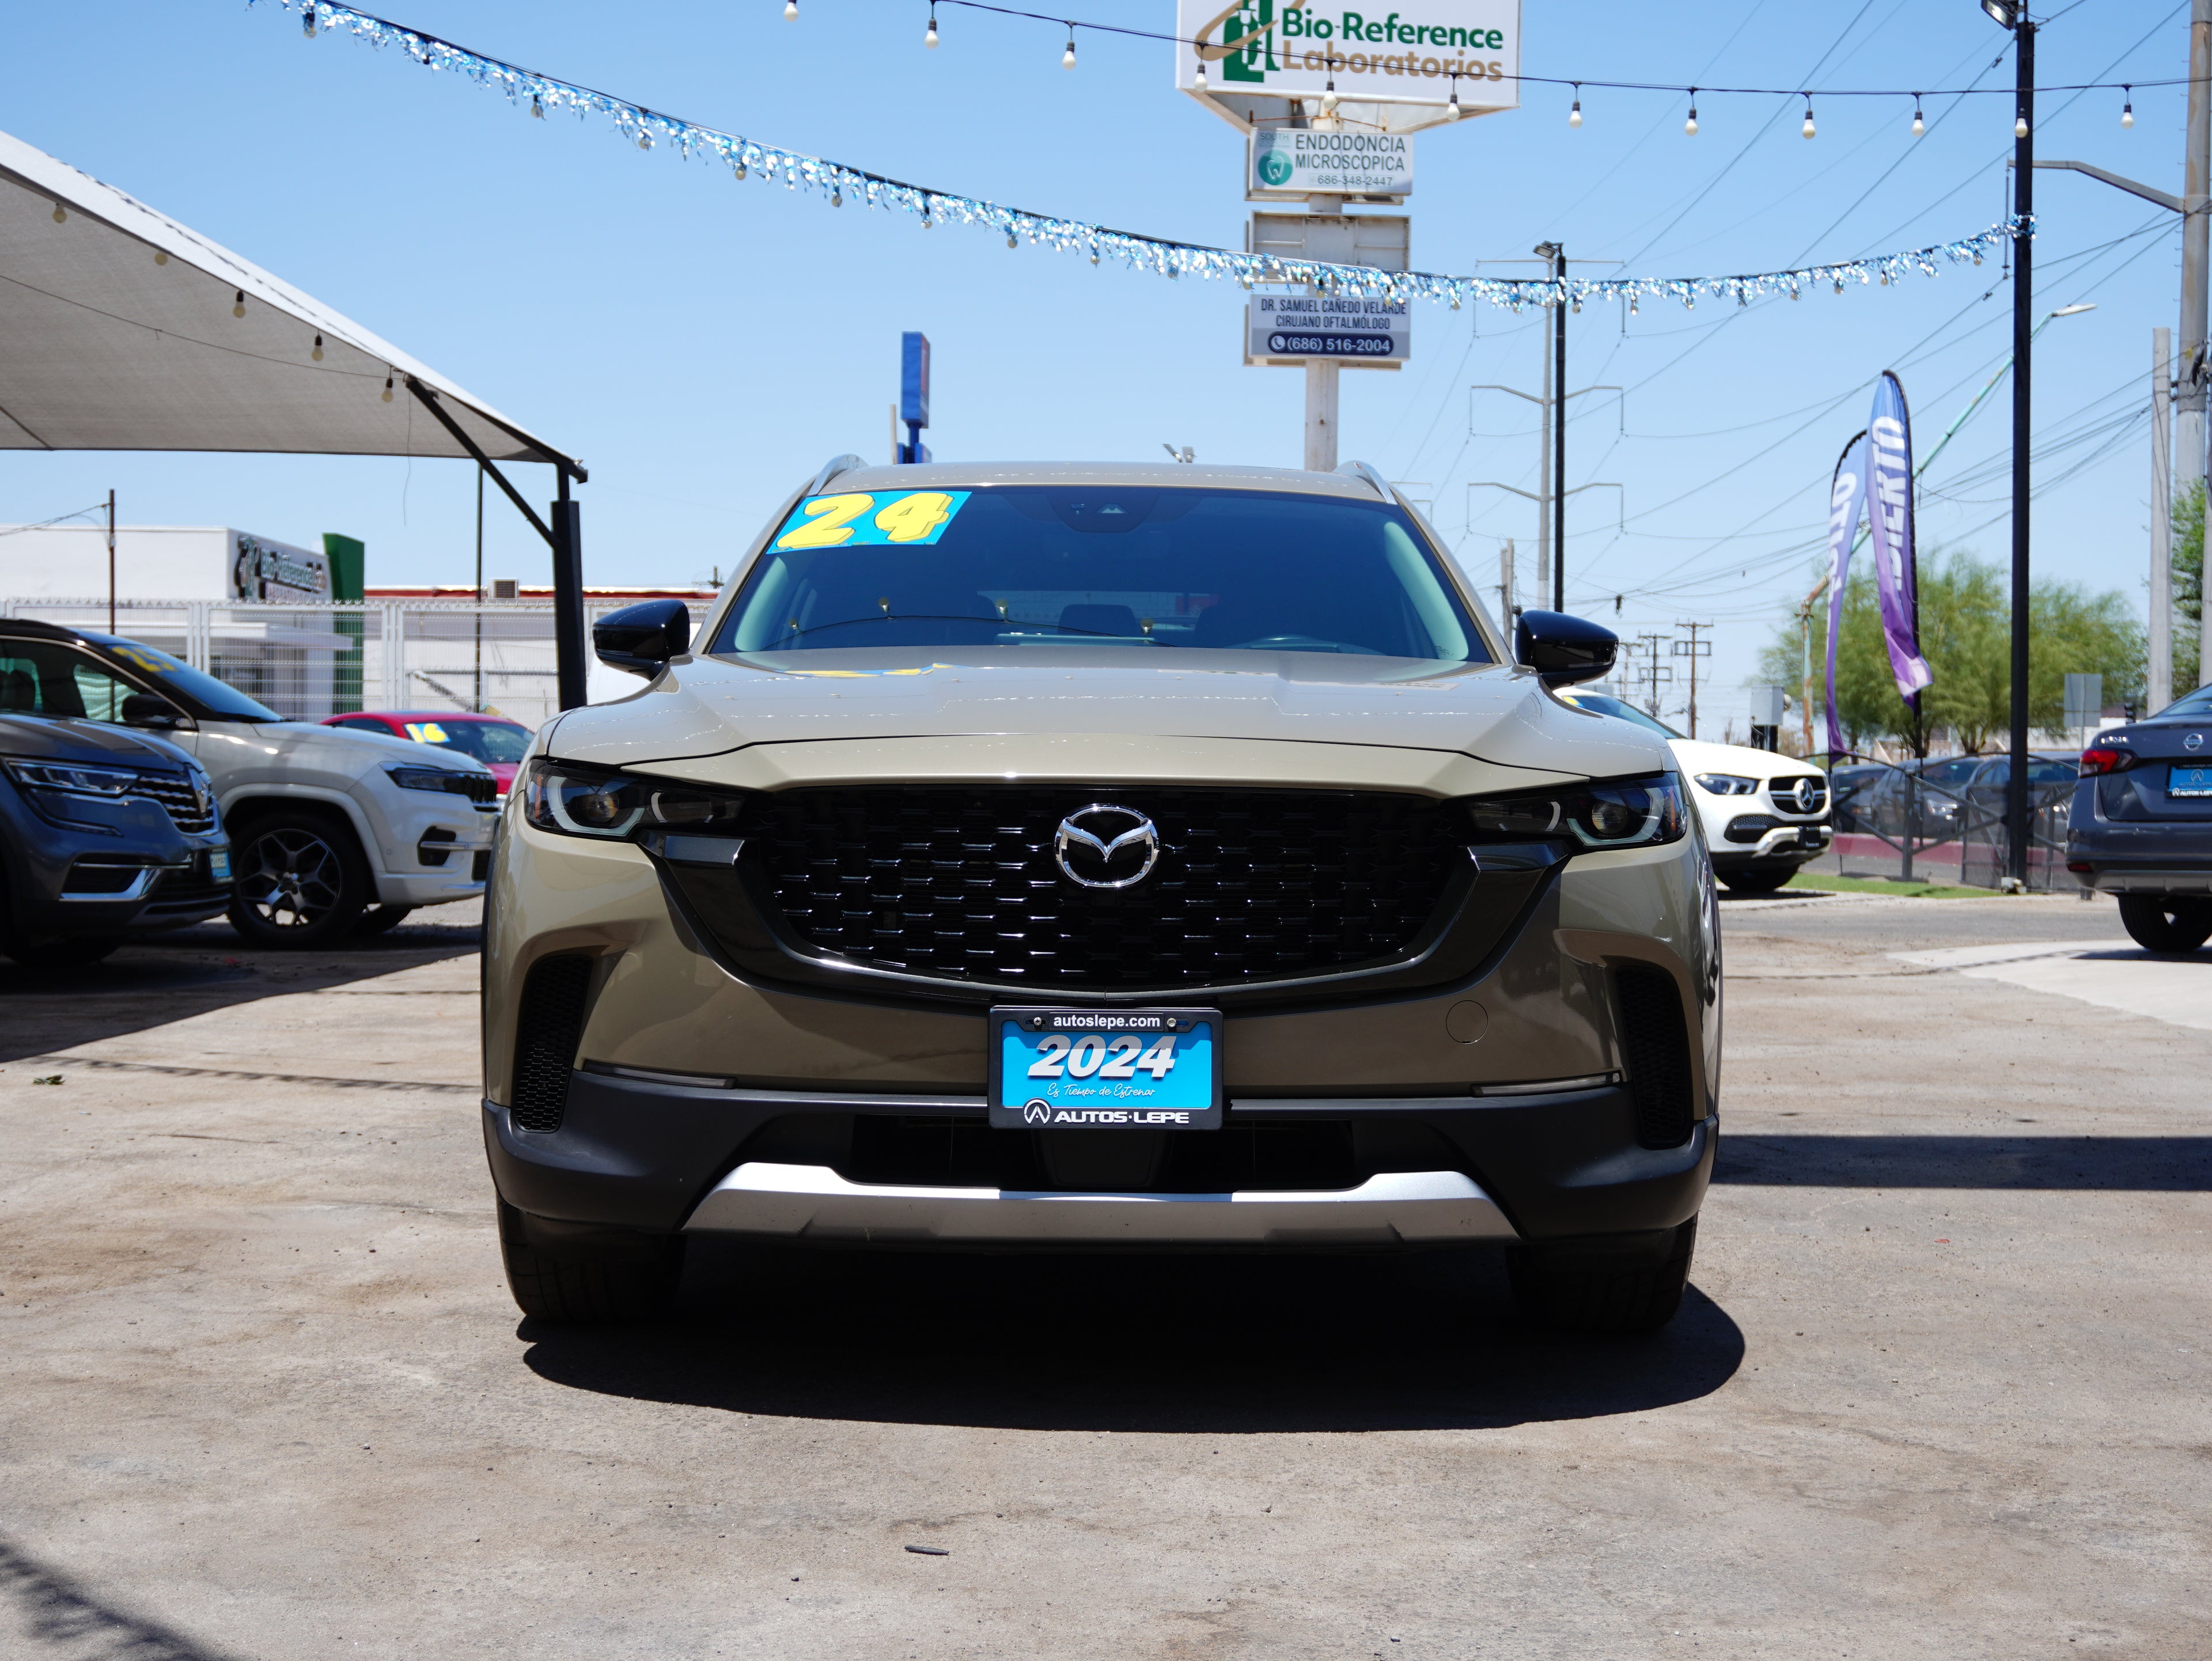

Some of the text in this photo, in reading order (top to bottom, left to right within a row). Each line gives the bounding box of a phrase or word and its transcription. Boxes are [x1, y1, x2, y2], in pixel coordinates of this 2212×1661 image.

[1282, 7, 1503, 50] Bio-Reference
[1283, 40, 1502, 82] Laboratorios
[1296, 134, 1405, 152] ENDODONCIA
[1296, 153, 1404, 171] MICROSCOPICA
[1317, 175, 1393, 186] 686-348-2447
[1261, 298, 1277, 311] DR.
[1280, 299, 1319, 312] SAMUEL
[1322, 298, 1360, 313] CAÑEDO
[1276, 315, 1390, 330] CIRUJANO OFTALMÓLOGO
[1287, 337, 1391, 352] (686) 516-2004
[777, 493, 954, 548] 24
[407, 723, 446, 743] 16
[1053, 1014, 1161, 1029] autoslepe.com
[1027, 1034, 1176, 1077] 2024
[1047, 1083, 1156, 1098] Es Tiempo de Estrenar
